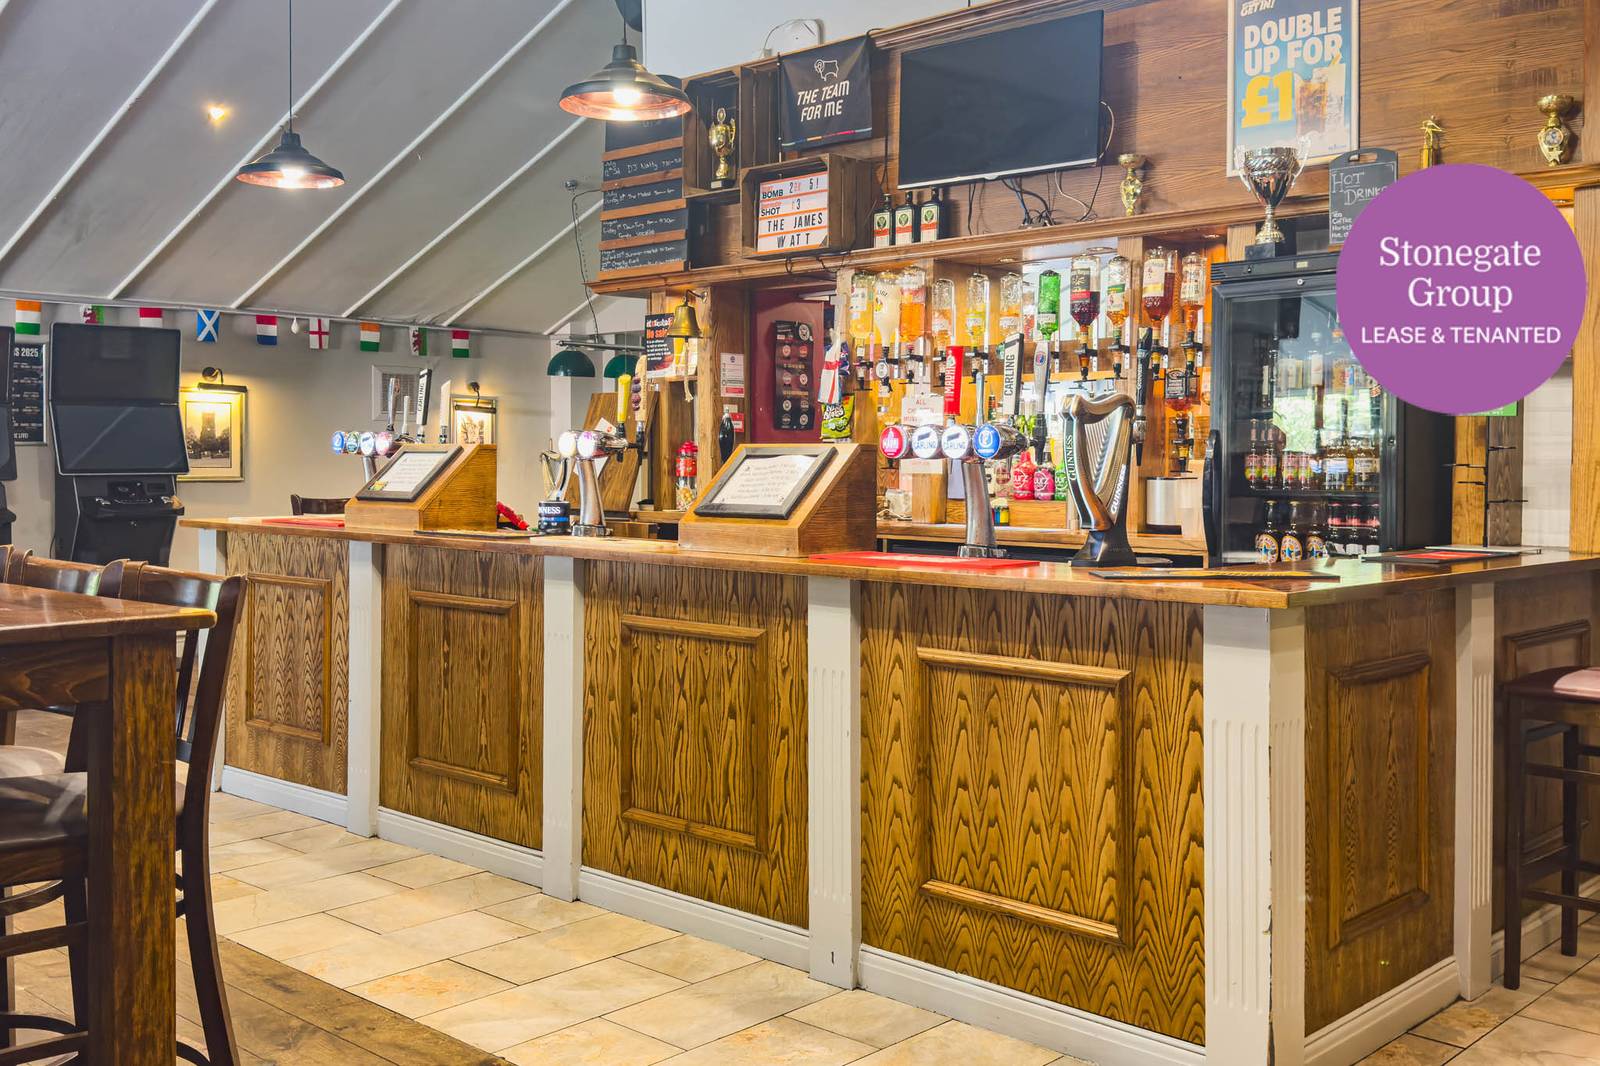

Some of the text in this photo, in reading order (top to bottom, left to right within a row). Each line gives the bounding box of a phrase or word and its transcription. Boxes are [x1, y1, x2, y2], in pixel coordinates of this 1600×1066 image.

[1244, 6, 1342, 49] DOUBLE
[1244, 33, 1342, 76] UP FOR
[797, 80, 850, 106] THE TEAM
[1241, 69, 1293, 128] £1
[801, 100, 843, 122] FOR ME
[762, 189, 784, 199] BOMB
[789, 182, 793, 193] 2
[1331, 172, 1365, 193] HOT
[761, 207, 780, 216] SHOT
[768, 212, 823, 232] THE JAMES
[777, 233, 810, 248] WATT
[21, 347, 39, 357] 2025
[1004, 353, 1016, 396] CARLING
[1066, 435, 1077, 481] GUINNESS
[1110, 464, 1127, 514] GUINNESS
